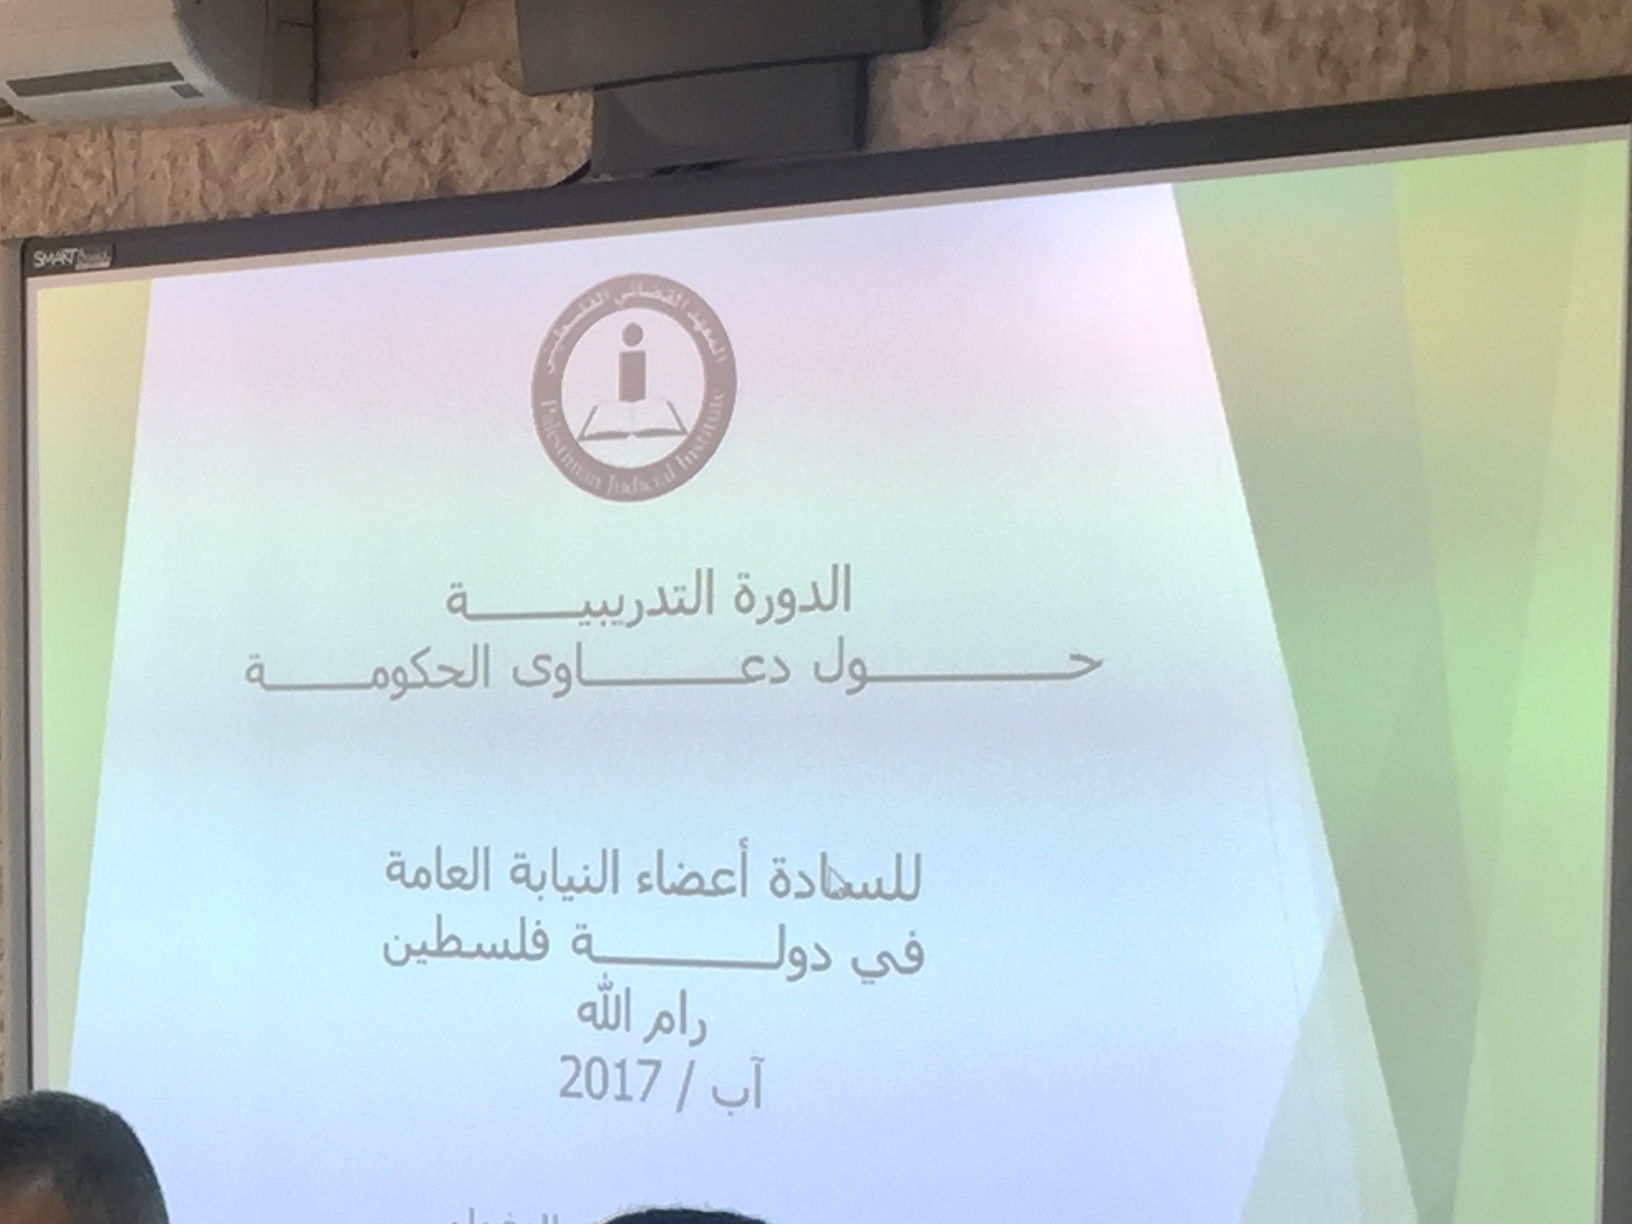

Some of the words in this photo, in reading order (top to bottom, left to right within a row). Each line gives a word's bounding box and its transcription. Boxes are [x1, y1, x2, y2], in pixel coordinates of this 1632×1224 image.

[33, 247, 78, 269] SMART
[734, 562, 852, 625] الدورة
[384, 844, 491, 892] العامة
[508, 846, 621, 902] النيابة
[635, 836, 749, 899] أعضاء
[382, 913, 550, 967] فلسطين
[850, 929, 926, 985] في
[575, 972, 632, 1034] الله
[642, 988, 709, 1047] رام
[558, 1053, 663, 1103] 2017
[675, 1058, 697, 1113] /
[711, 1055, 766, 1117] آب
